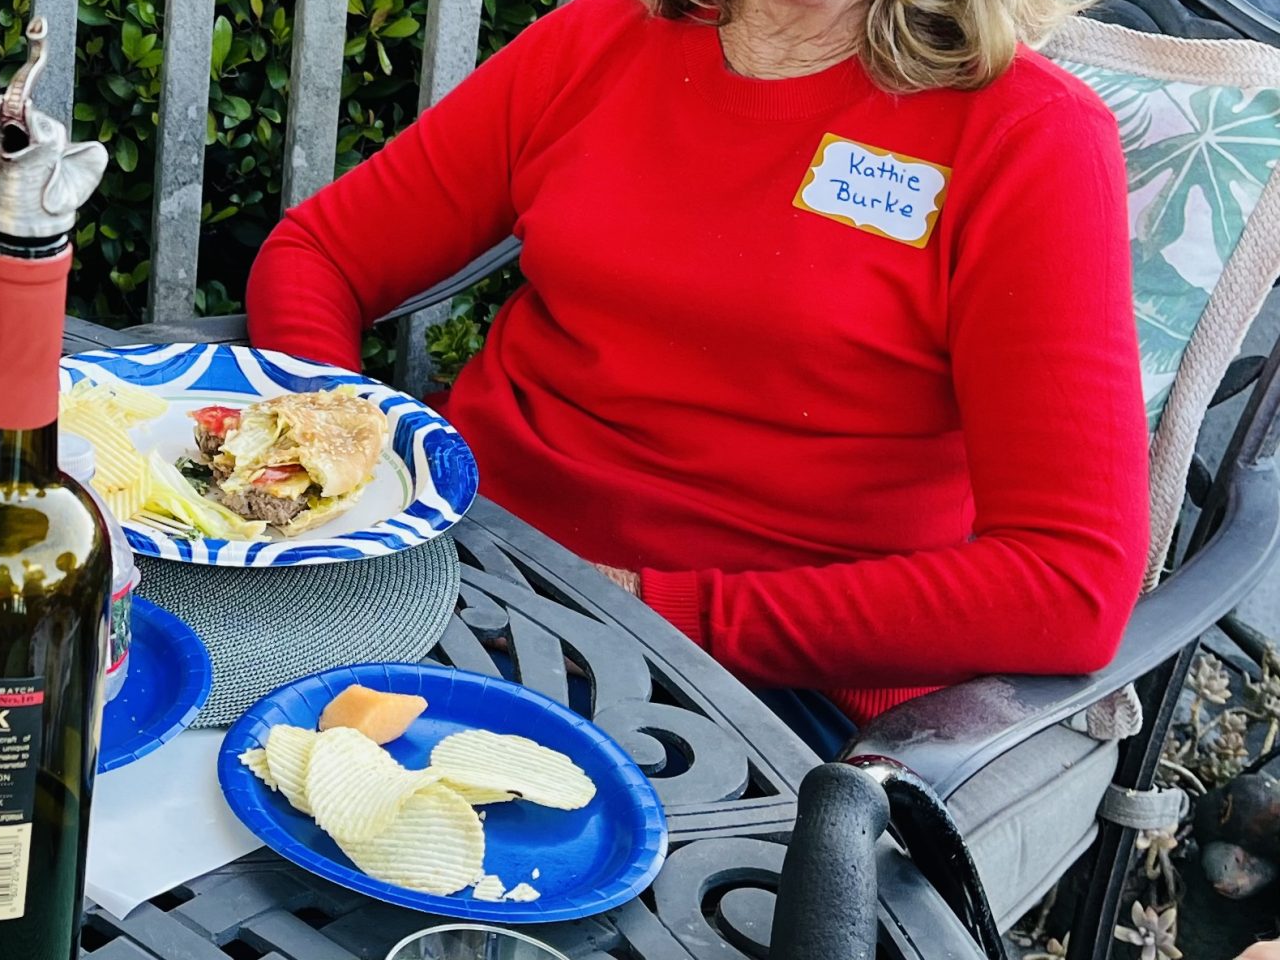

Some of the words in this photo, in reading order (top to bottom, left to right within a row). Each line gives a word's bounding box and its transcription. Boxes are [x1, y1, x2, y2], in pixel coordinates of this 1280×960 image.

[849, 151, 921, 192] Kathie
[829, 178, 913, 218] Burke
[0, 686, 35, 695] BATCH
